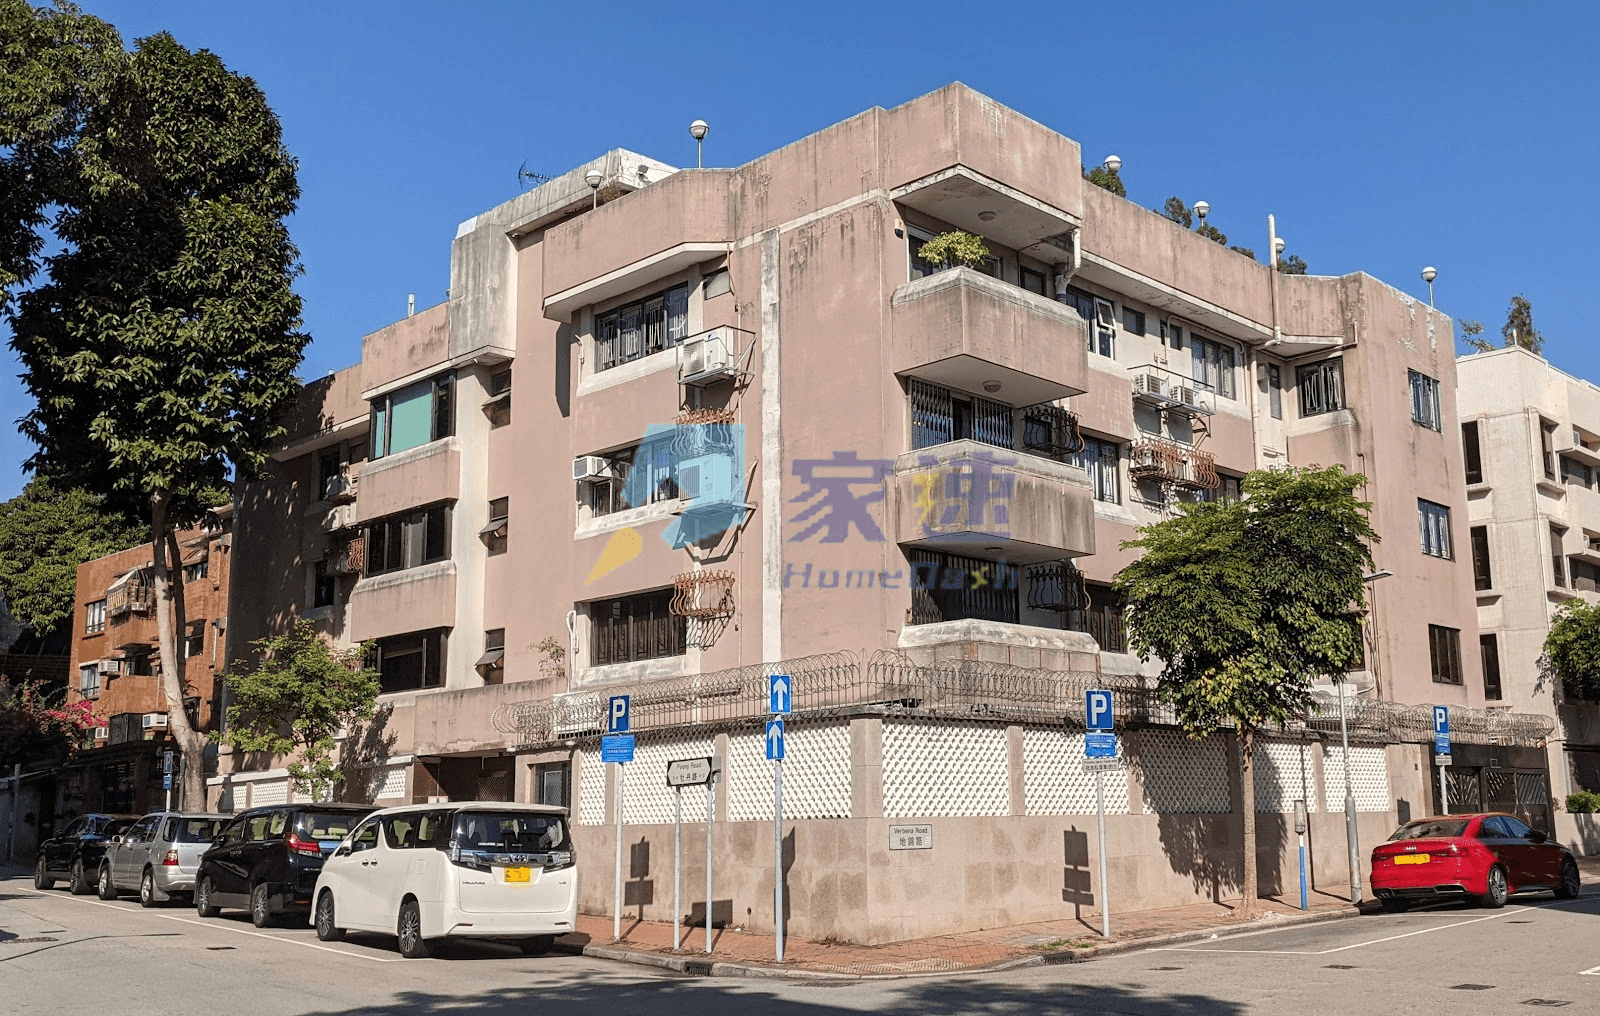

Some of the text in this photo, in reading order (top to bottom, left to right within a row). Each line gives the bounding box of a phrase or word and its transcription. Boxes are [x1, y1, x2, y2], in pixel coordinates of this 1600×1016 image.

[612, 698, 626, 729] P
[1090, 693, 1107, 726] P
[1435, 708, 1446, 731] P
[690, 761, 702, 769] Road
